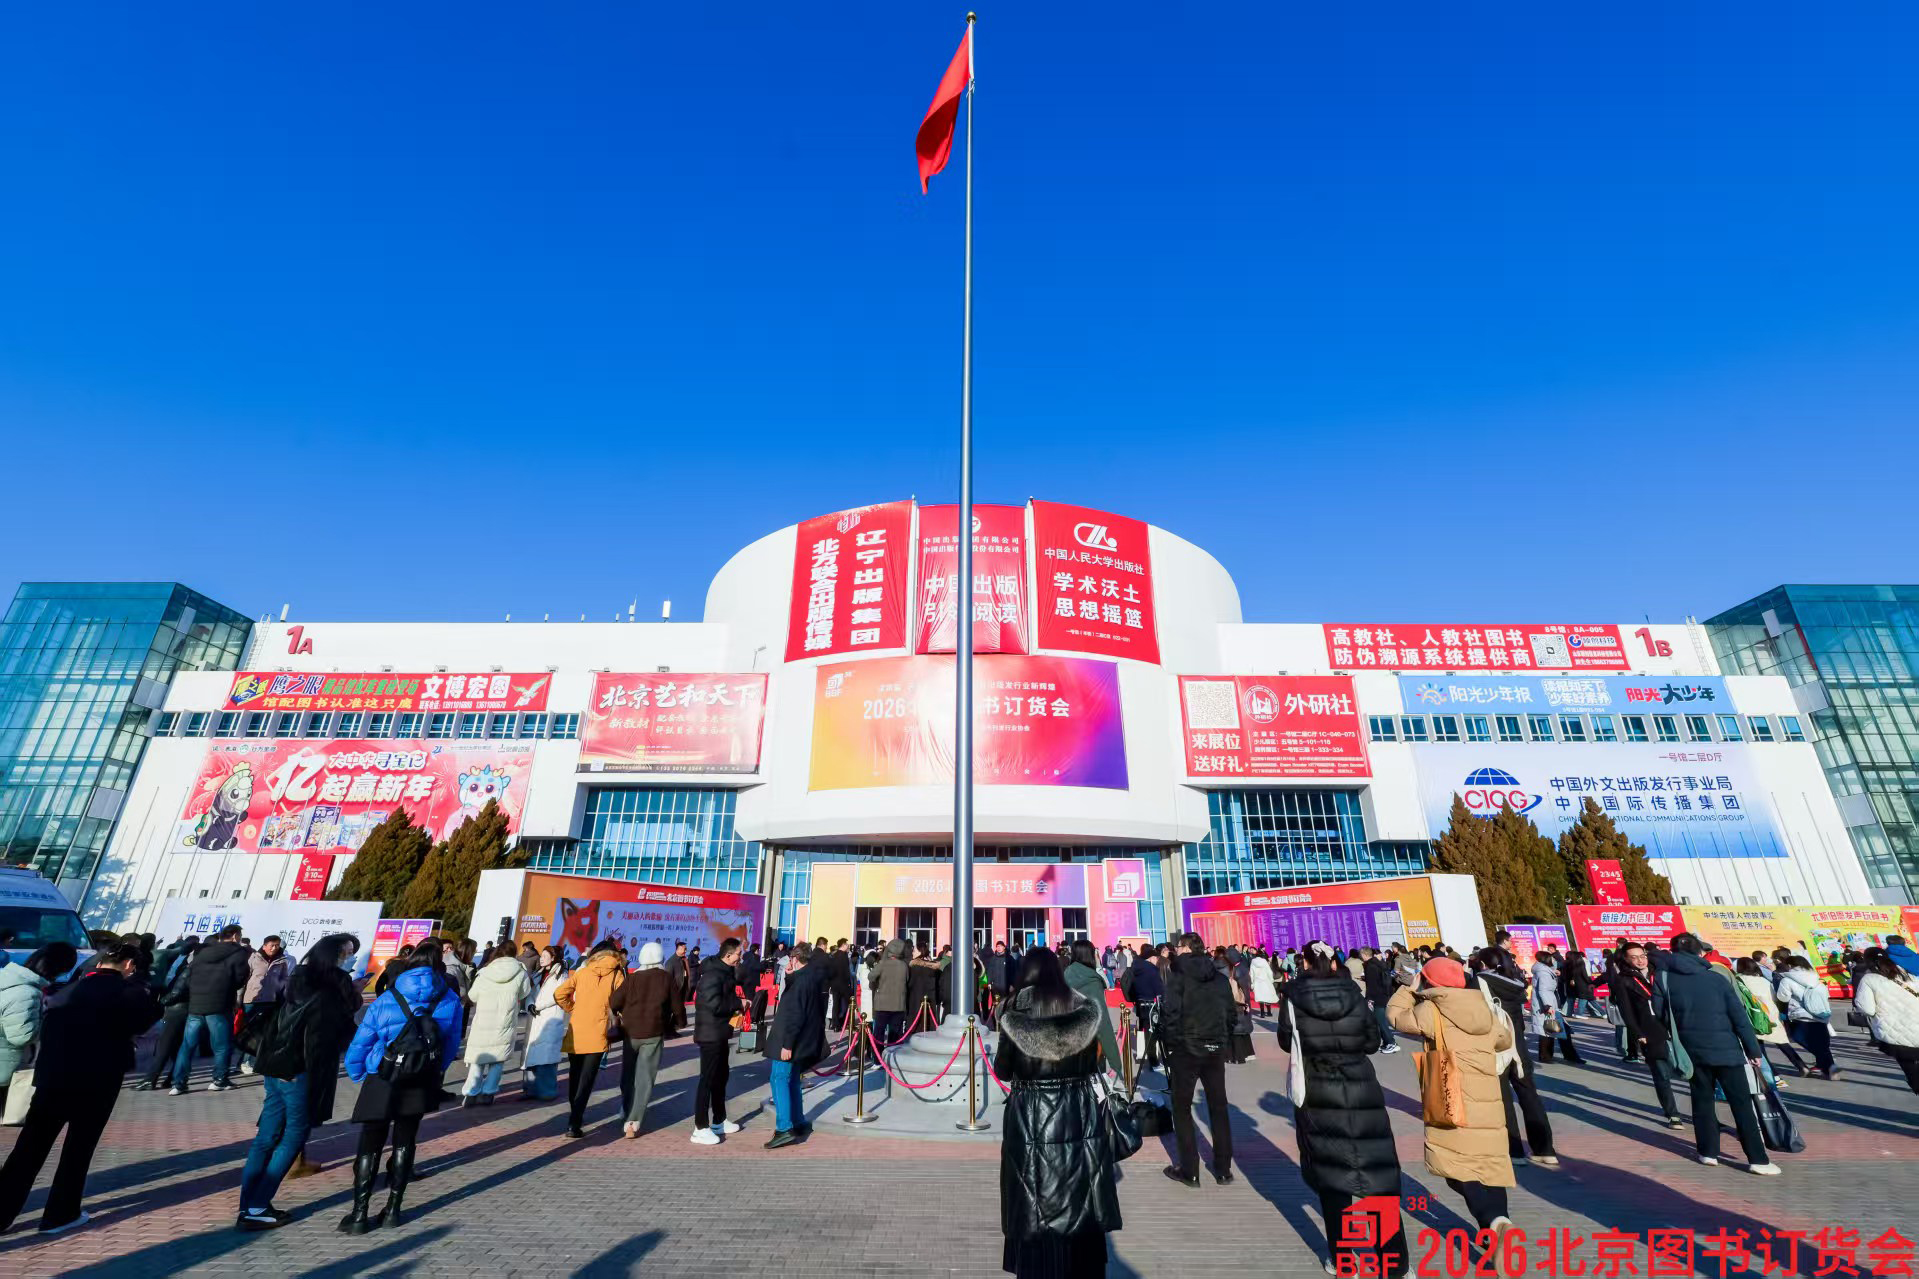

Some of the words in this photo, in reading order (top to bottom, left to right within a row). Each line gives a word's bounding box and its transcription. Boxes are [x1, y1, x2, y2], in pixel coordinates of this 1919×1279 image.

[923, 535, 1019, 545] 中国出版团有限公司
[1044, 547, 1145, 576] 中国人民大学出版社
[804, 537, 840, 651] 北方联合出版传媒
[850, 529, 887, 645] 辽宁出版集团
[1053, 571, 1141, 604] 学术沃土
[1054, 597, 1144, 629] 思想摇篮
[287, 625, 312, 655] 1A
[1331, 628, 1526, 647] 高教社、人教社图书
[1635, 627, 1673, 657] 1B
[1334, 648, 1532, 667] 防伪溯源系统提供商
[267, 674, 325, 695] 鹰之眼
[420, 675, 511, 699] 文博宏图
[600, 682, 762, 710] 北京艺和天下
[1449, 685, 1534, 704] 阳光少年报
[1625, 683, 1716, 706] 阳光大少年
[262, 697, 412, 709] 馆配图书认准这只鹰
[1284, 693, 1354, 716] 外研社
[1192, 733, 1241, 750] 来展位
[328, 751, 428, 771] 大中华寻宝记
[1194, 755, 1243, 773] 送好礼
[1659, 752, 1723, 763] 一号馆二层D厅
[318, 773, 436, 803] 起赢新年
[1550, 776, 1734, 791] 中国外文出版发行事业局
[1718, 814, 1745, 823] GROUP
[1703, 911, 1776, 921] 中华先锋人物故事汇
[1721, 921, 1763, 930] 图画书系列
[1811, 911, 1889, 922] 尤斯伯恩发声玩具书
